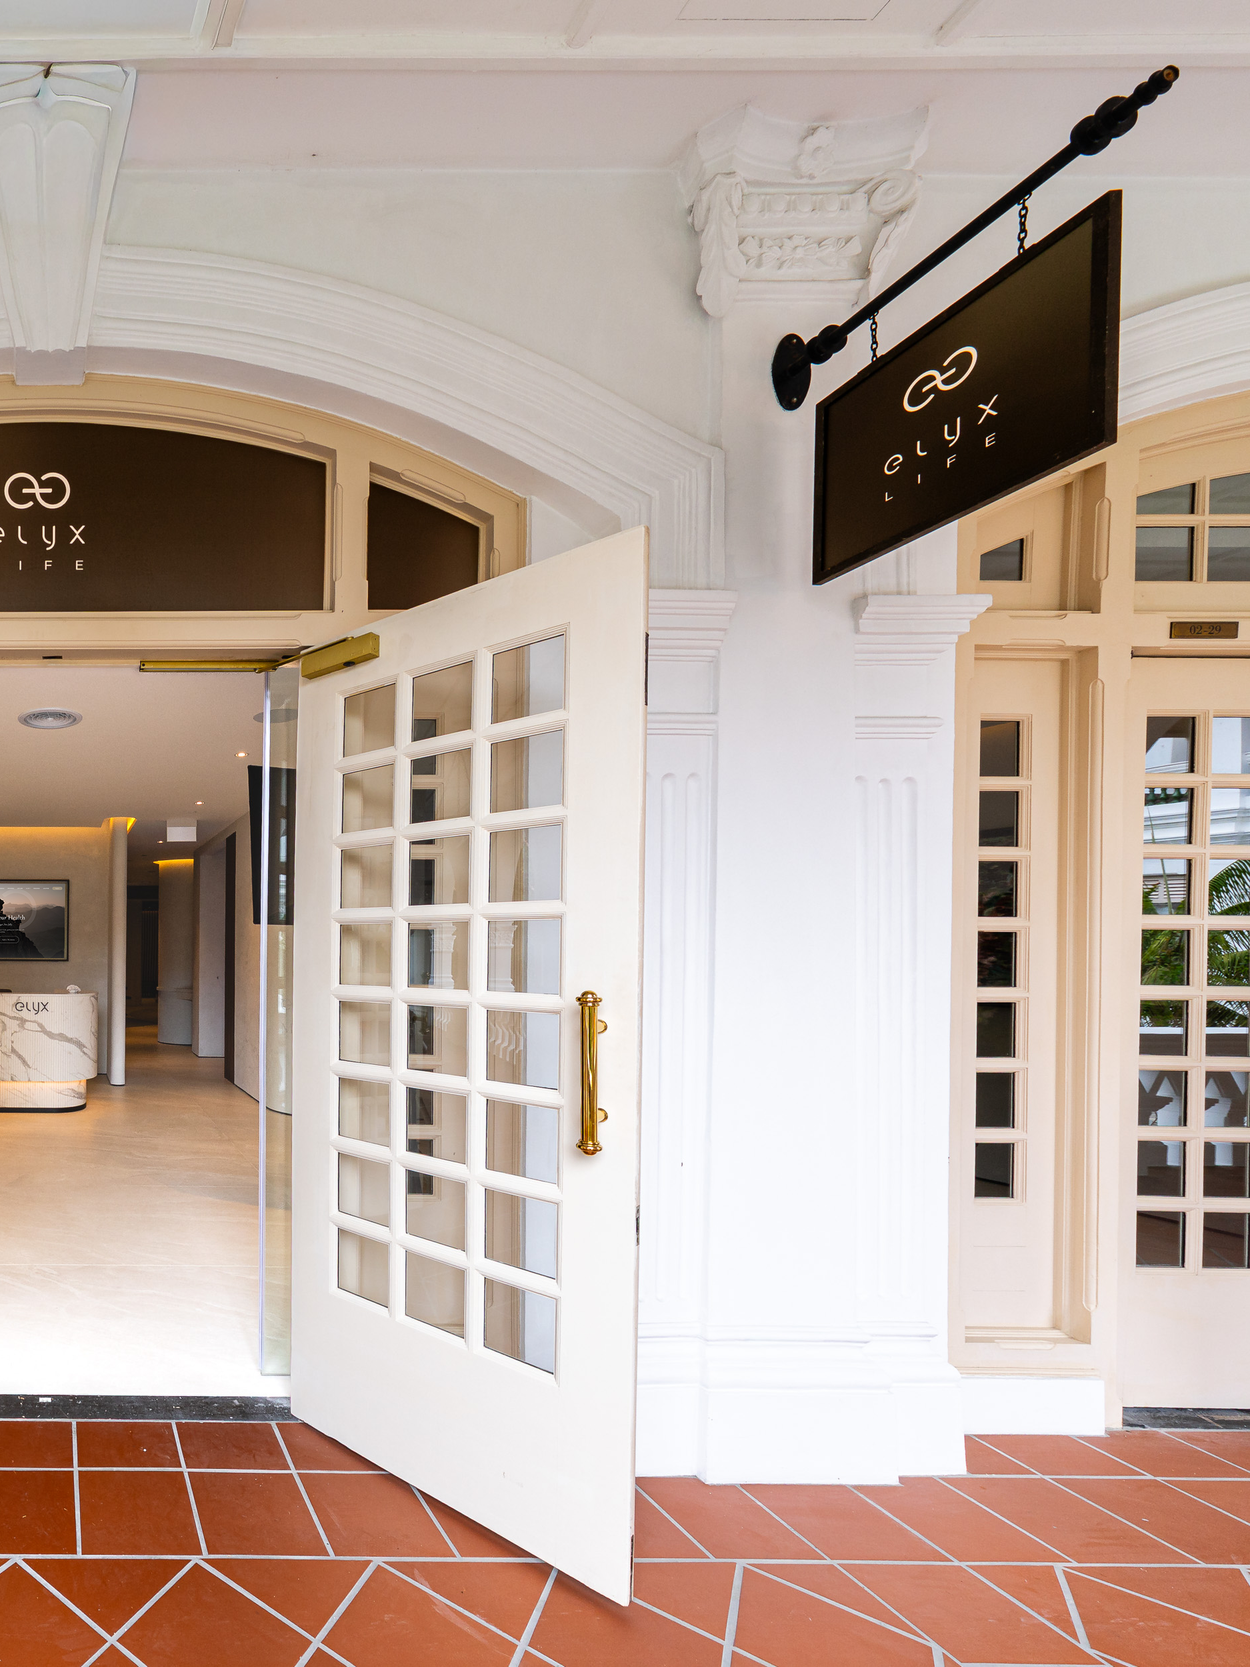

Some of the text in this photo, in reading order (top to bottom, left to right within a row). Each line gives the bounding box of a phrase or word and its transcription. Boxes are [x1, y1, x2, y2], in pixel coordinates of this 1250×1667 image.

[884, 394, 999, 475] elyx
[885, 432, 996, 502] LIFE
[1189, 624, 1222, 635] 02-29
[14, 1001, 49, 1015] elyx
